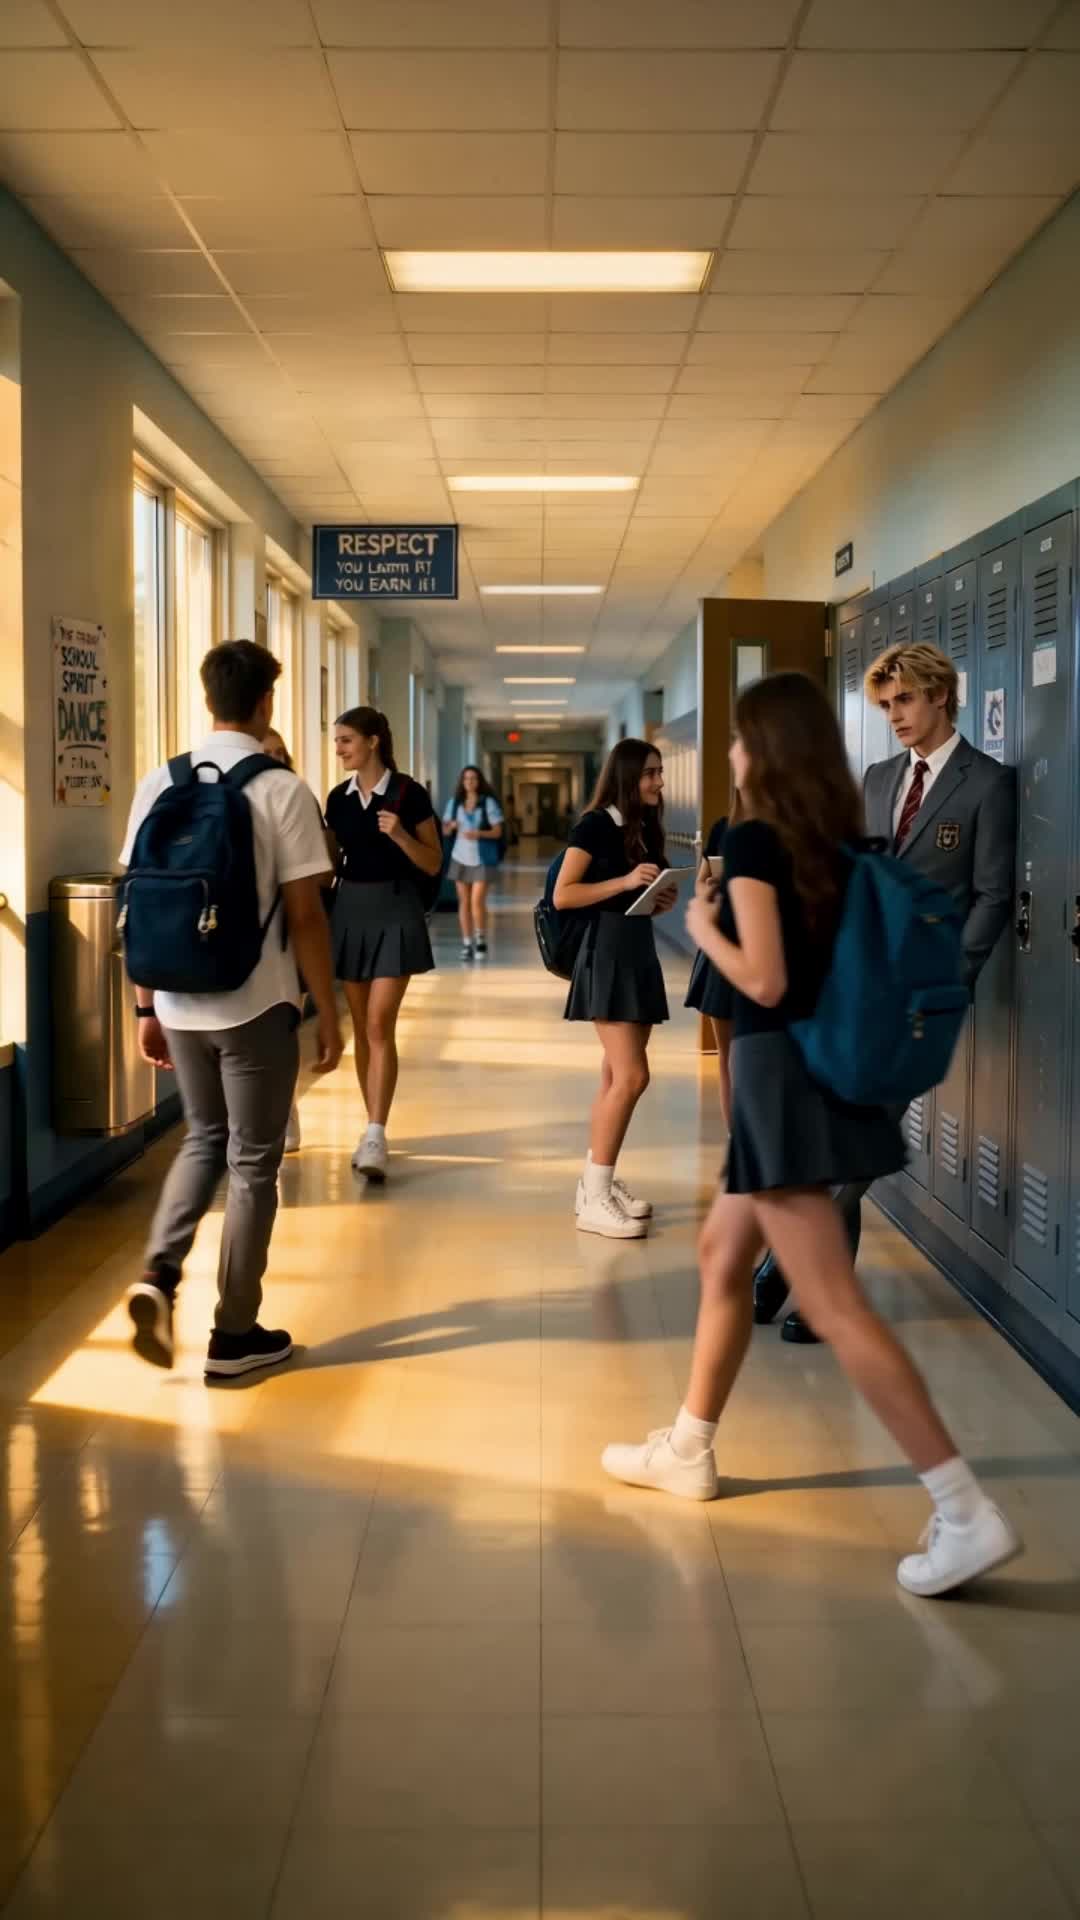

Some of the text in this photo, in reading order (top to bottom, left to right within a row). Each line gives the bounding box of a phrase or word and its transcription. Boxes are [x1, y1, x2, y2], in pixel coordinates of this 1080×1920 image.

[337, 533, 439, 556] RESPECT
[336, 561, 363, 574] YOU
[335, 578, 364, 592] YOU
[369, 578, 411, 592] EARN
